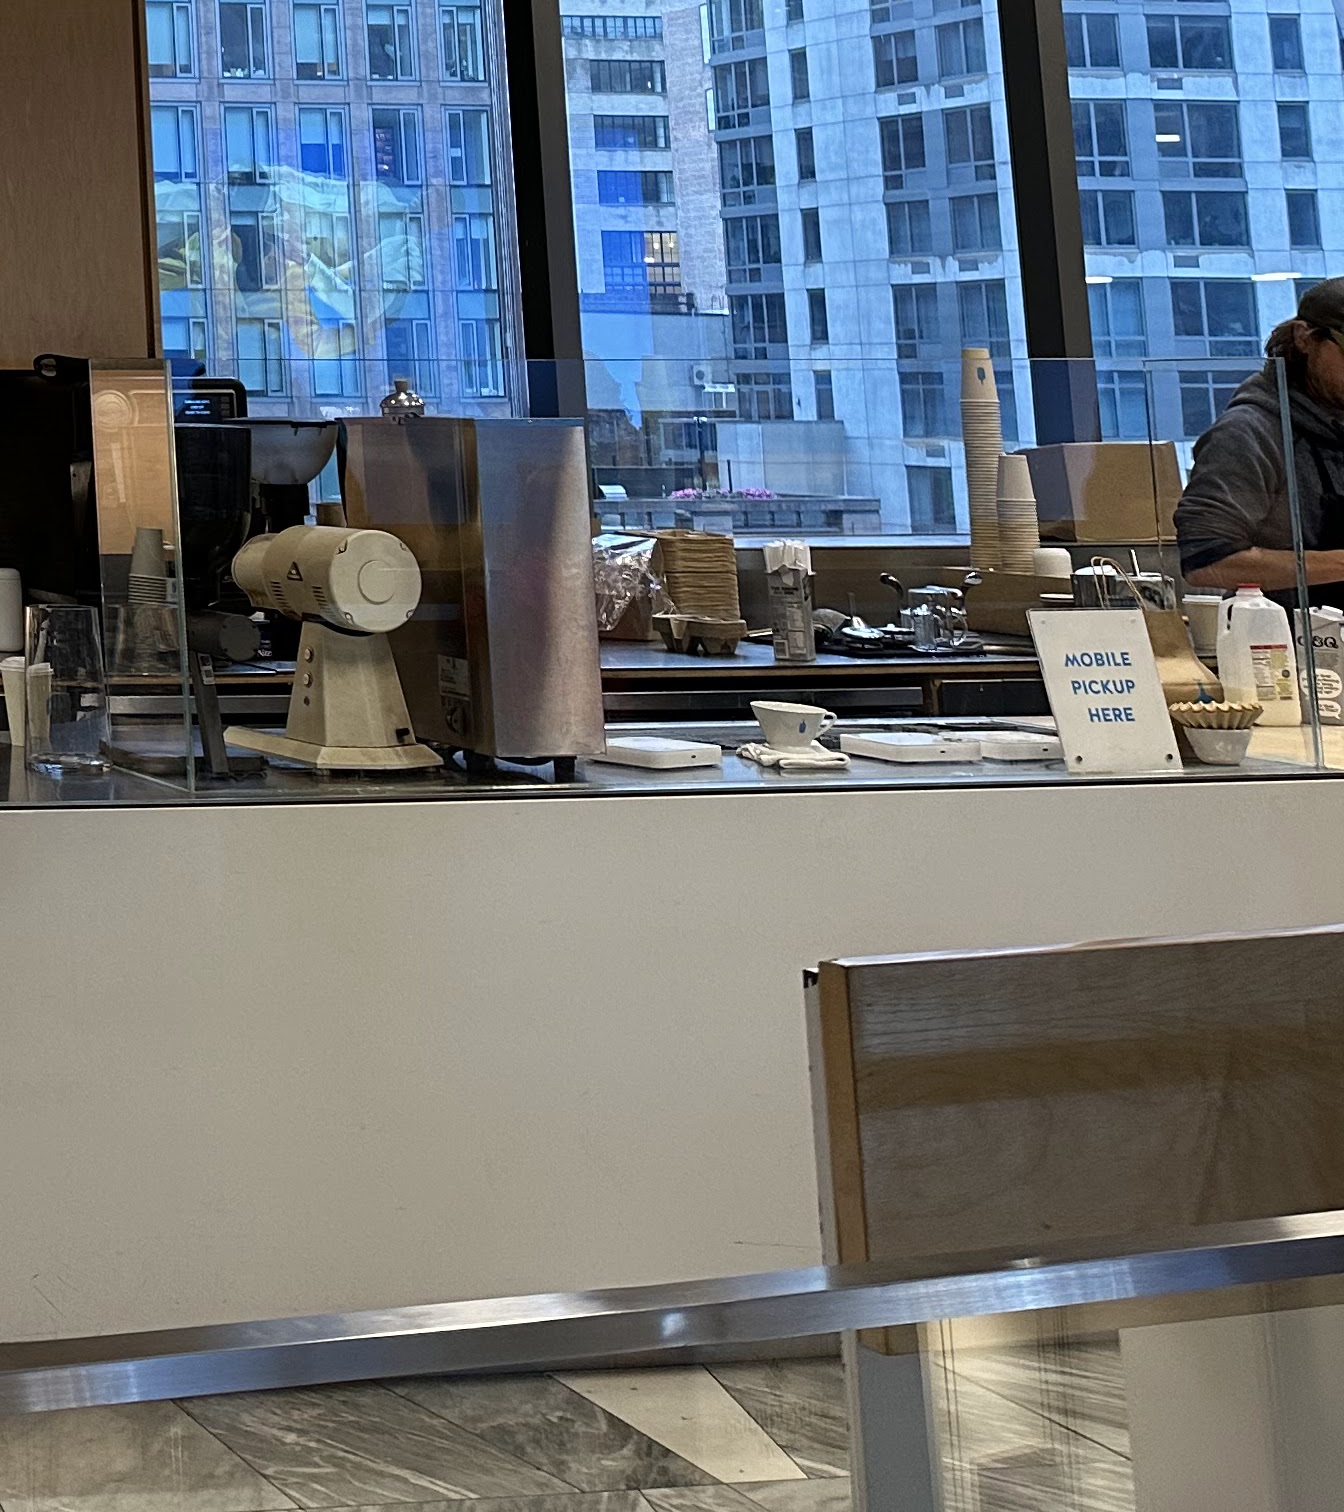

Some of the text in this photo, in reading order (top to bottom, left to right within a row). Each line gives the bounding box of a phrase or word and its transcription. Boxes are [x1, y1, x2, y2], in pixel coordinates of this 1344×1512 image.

[1065, 652, 1132, 667] MOBILE
[1071, 679, 1135, 694] PICKUP
[1088, 707, 1136, 722] HERE
